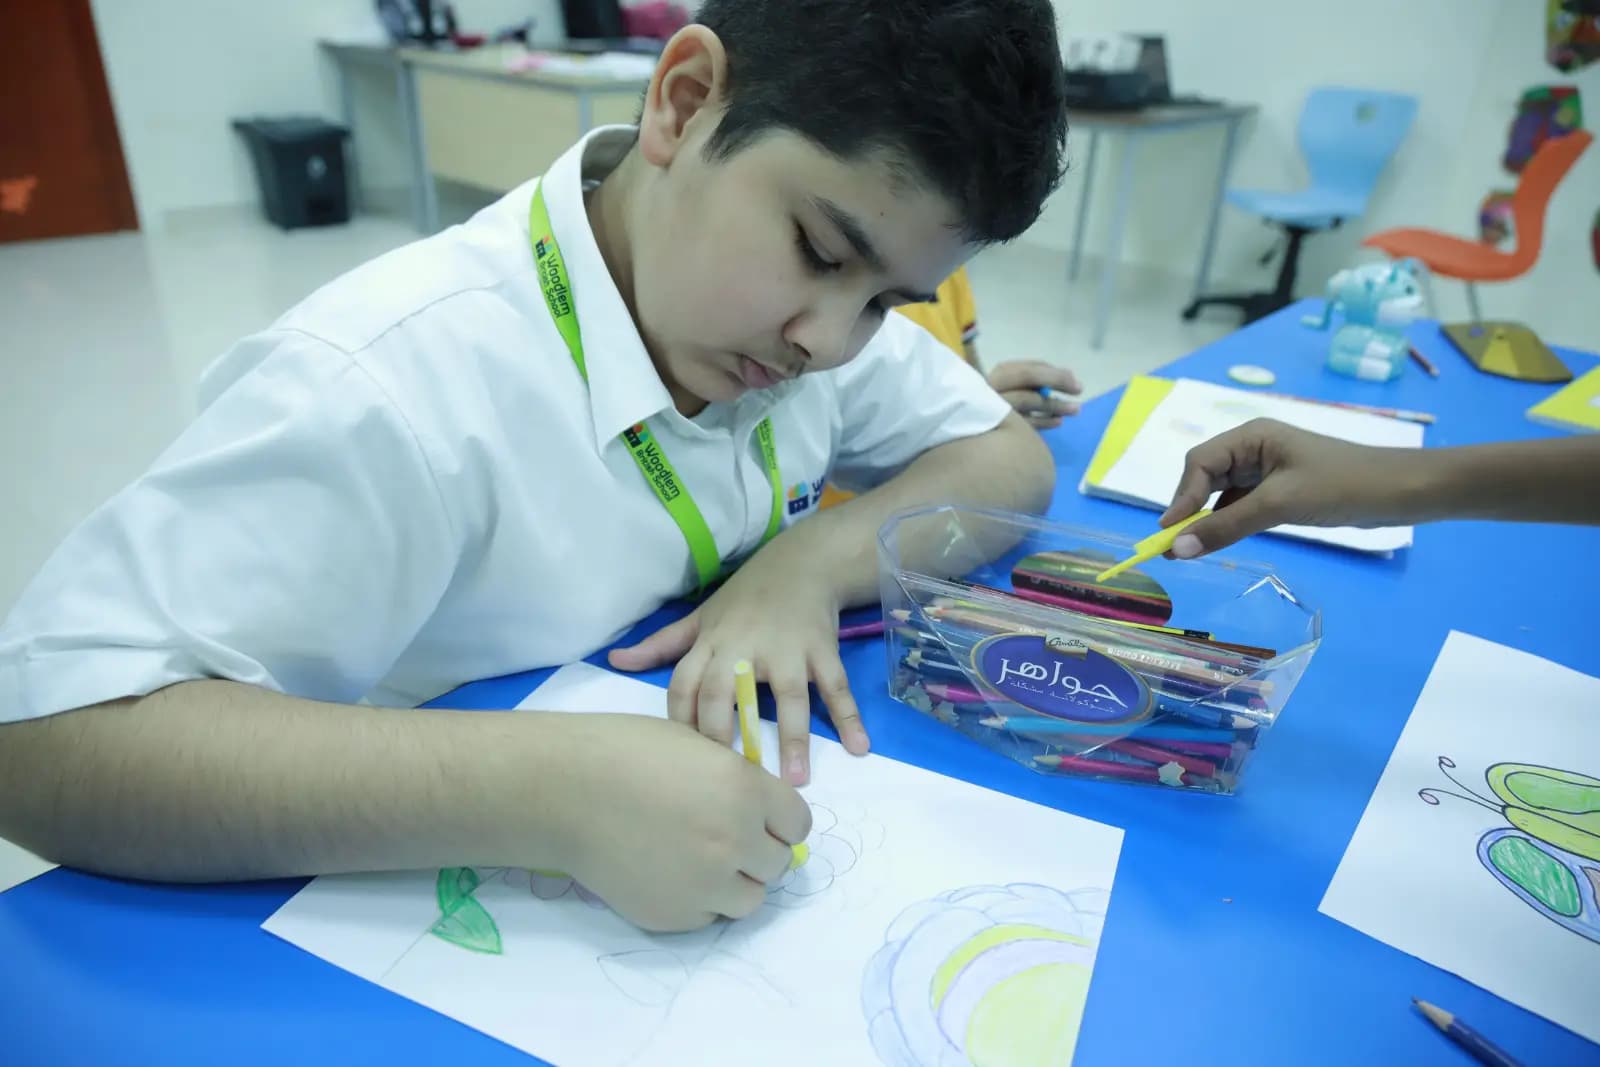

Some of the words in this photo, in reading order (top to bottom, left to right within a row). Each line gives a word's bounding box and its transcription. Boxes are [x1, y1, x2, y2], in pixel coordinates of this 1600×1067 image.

[545, 288, 561, 318] School
[546, 252, 571, 315] Woodlem
[636, 449, 655, 475] British
[652, 474, 673, 502] School
[645, 443, 680, 497] Woodlem
[995, 658, 1128, 709] جواهر
